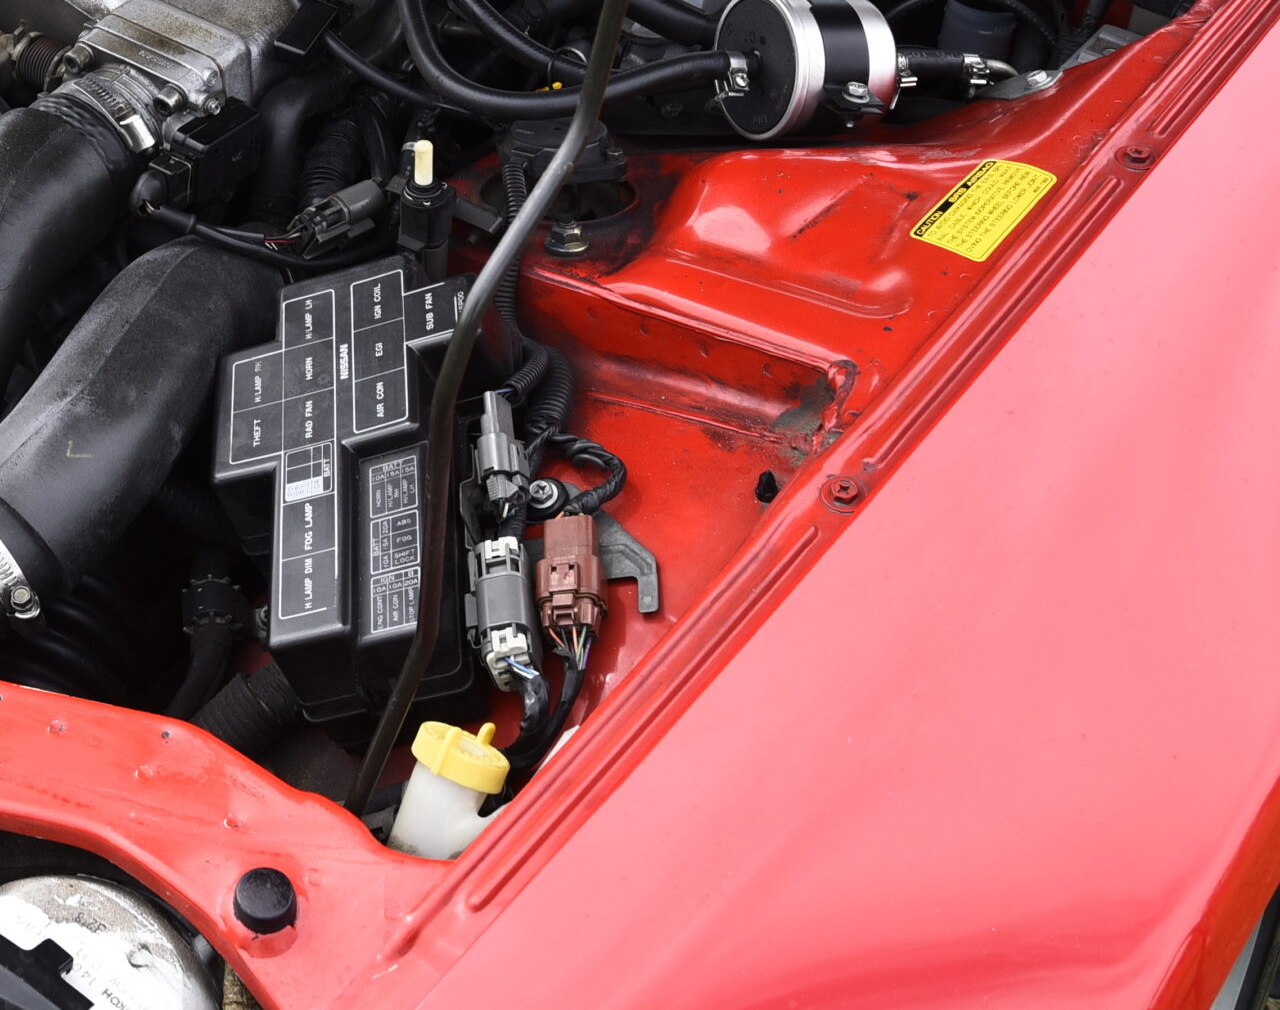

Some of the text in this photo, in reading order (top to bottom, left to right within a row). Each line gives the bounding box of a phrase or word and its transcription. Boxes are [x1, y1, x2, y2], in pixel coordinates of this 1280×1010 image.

[916, 160, 994, 234] CAUTION SRS AIRBAG
[304, 299, 313, 309] LH
[373, 283, 382, 319] IGN COIL
[425, 292, 434, 331] SUB FAN
[340, 344, 349, 380] NISSAN
[375, 342, 383, 357] EGI
[305, 357, 313, 380] HORN
[376, 382, 384, 418] AIR CON
[253, 419, 262, 447] THEFT
[304, 400, 313, 438] RAD FAN
[323, 458, 331, 477] BATT
[304, 502, 313, 550] FOG LAMP
[304, 558, 313, 574] DIM
